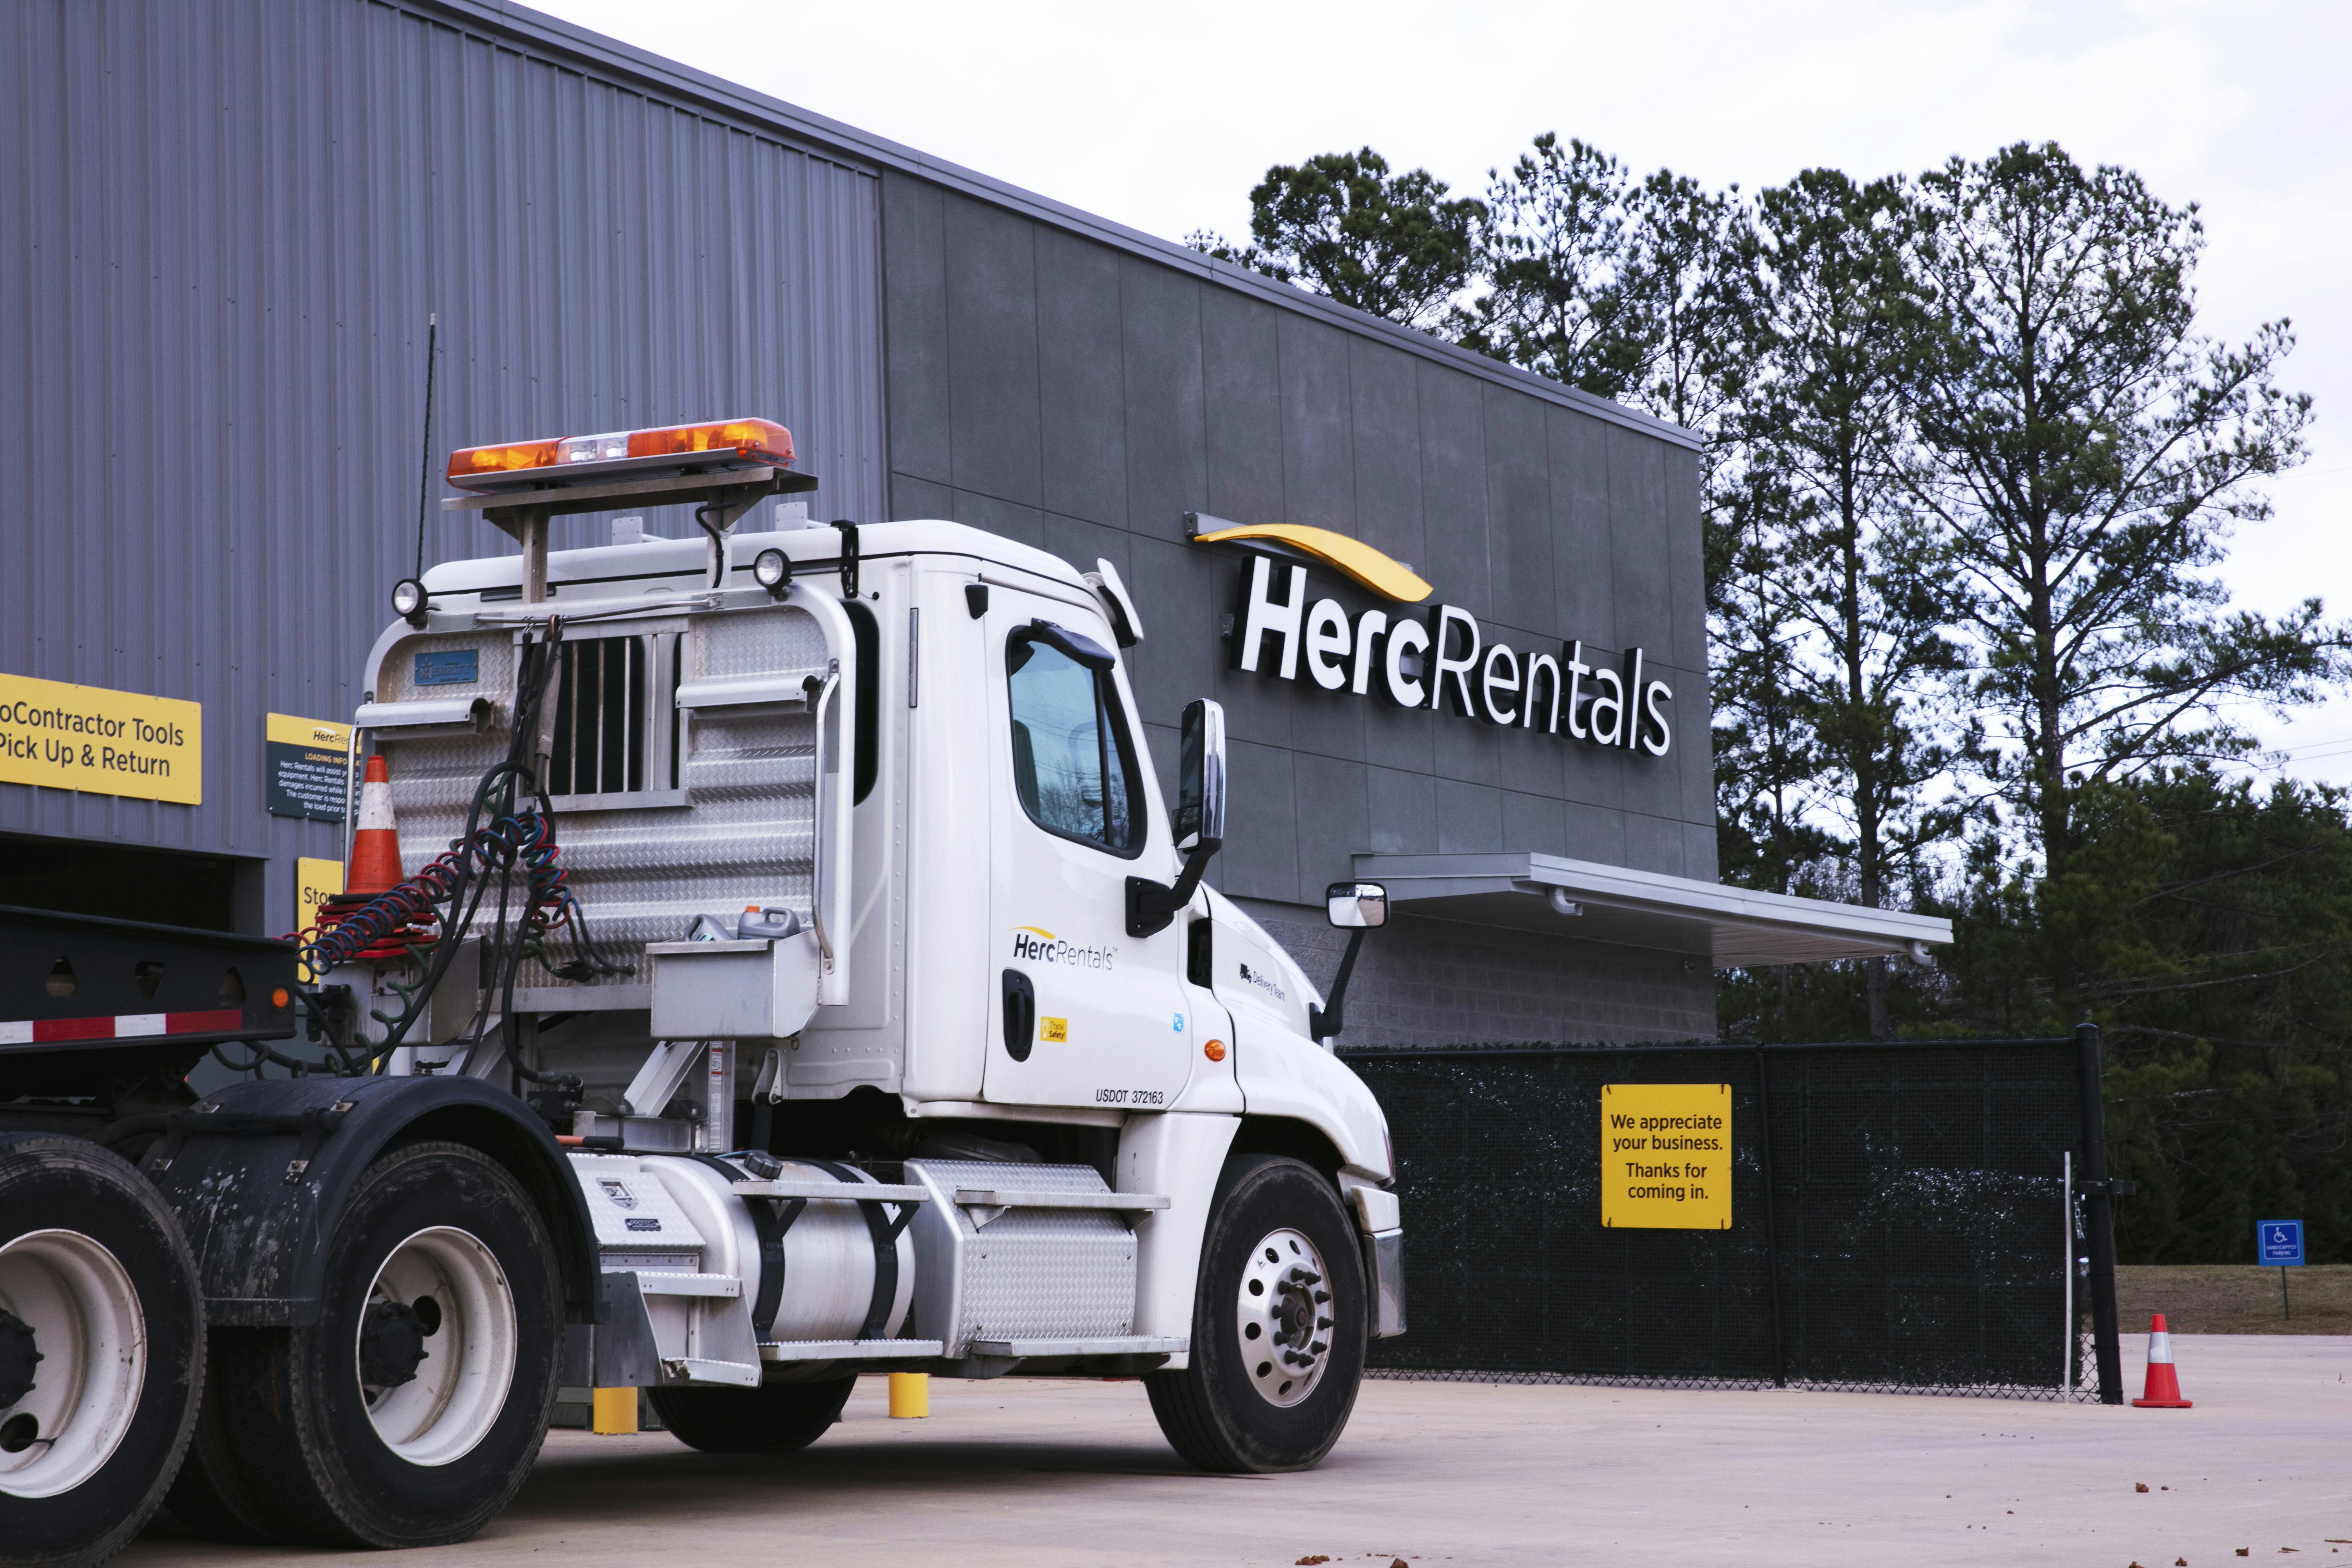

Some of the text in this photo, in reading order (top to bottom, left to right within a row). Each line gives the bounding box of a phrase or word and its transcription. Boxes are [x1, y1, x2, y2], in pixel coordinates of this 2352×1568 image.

[1232, 555, 1672, 757] HercRentals
[132, 718, 184, 747] Tools
[46, 738, 74, 768] Up
[81, 743, 94, 767] &
[103, 746, 170, 777] Return
[305, 752, 332, 763] LOADING
[280, 760, 294, 769] Herc
[294, 762, 315, 772] Rentals
[278, 770, 310, 781] equipment.
[310, 774, 324, 783] Herc
[324, 775, 345, 785] Rentals
[278, 779, 305, 790] damages
[305, 782, 328, 792] incurred
[286, 789, 297, 798] The
[297, 791, 323, 801] customer
[303, 801, 313, 809] the
[1013, 934, 1113, 971] HercRentals
[1253, 971, 1285, 1002] Delivery Team
[1050, 1021, 1064, 1030] Think
[1049, 1030, 1066, 1040] Safety!
[1096, 1089, 1164, 1104] USDOT 372163
[1610, 1114, 1722, 1132] We appreciate
[1613, 1135, 1723, 1152] your business.
[1625, 1162, 1707, 1178] Thanks for
[1628, 1183, 1708, 1201] coming in.
